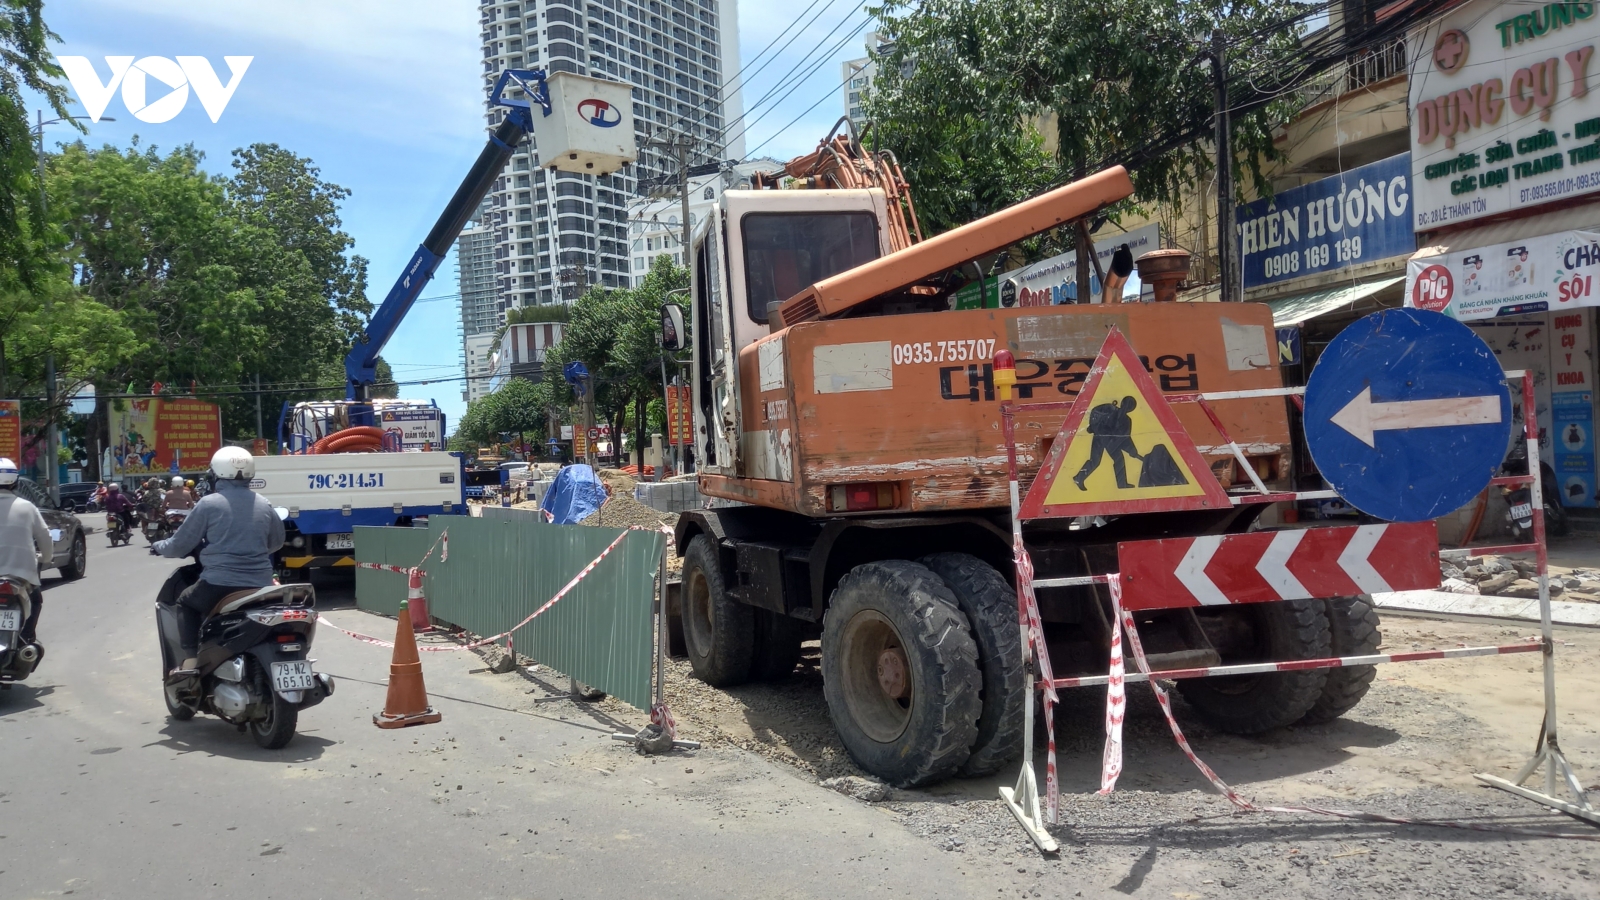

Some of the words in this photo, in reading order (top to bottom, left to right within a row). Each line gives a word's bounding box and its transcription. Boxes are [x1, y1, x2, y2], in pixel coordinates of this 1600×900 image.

[1495, 0, 1595, 48] TRUNG
[1416, 78, 1504, 150] DỤNG
[1510, 57, 1559, 122] CỤ
[1565, 45, 1594, 98] Y
[1424, 152, 1480, 180] CHUYÊN:
[1485, 140, 1514, 164] SỬA
[1516, 128, 1558, 156] CHỮA
[1450, 172, 1477, 195] CÁC
[1479, 165, 1509, 188] LOẠI
[1512, 152, 1564, 180] TRANG
[1237, 205, 1300, 256] HIÊN
[1306, 175, 1409, 239] HƯƠNG
[1418, 212, 1430, 226] ĐC:
[1448, 199, 1472, 219] THÁNH
[1473, 197, 1487, 213] TÔN
[1264, 251, 1299, 278] 0908
[1304, 243, 1330, 270] 169
[1334, 235, 1362, 263] 139
[1460, 301, 1475, 309] BĂNG
[1485, 298, 1502, 307] NHÂN
[1503, 294, 1524, 303] KHÁNG
[1525, 291, 1548, 300] KHUẨN
[1554, 314, 1582, 332] DỤNG
[1561, 333, 1575, 349] CỤ
[893, 338, 996, 365] 0935.755707
[1565, 352, 1572, 366] Y
[1557, 371, 1585, 386] KHOA
[404, 430, 417, 439] GIẢM
[418, 430, 427, 439] TỐC
[428, 430, 436, 440] ĐỘ
[307, 473, 384, 489] 79C-214.51
[279, 663, 306, 675] 79-N2
[277, 675, 312, 688] 165.18
